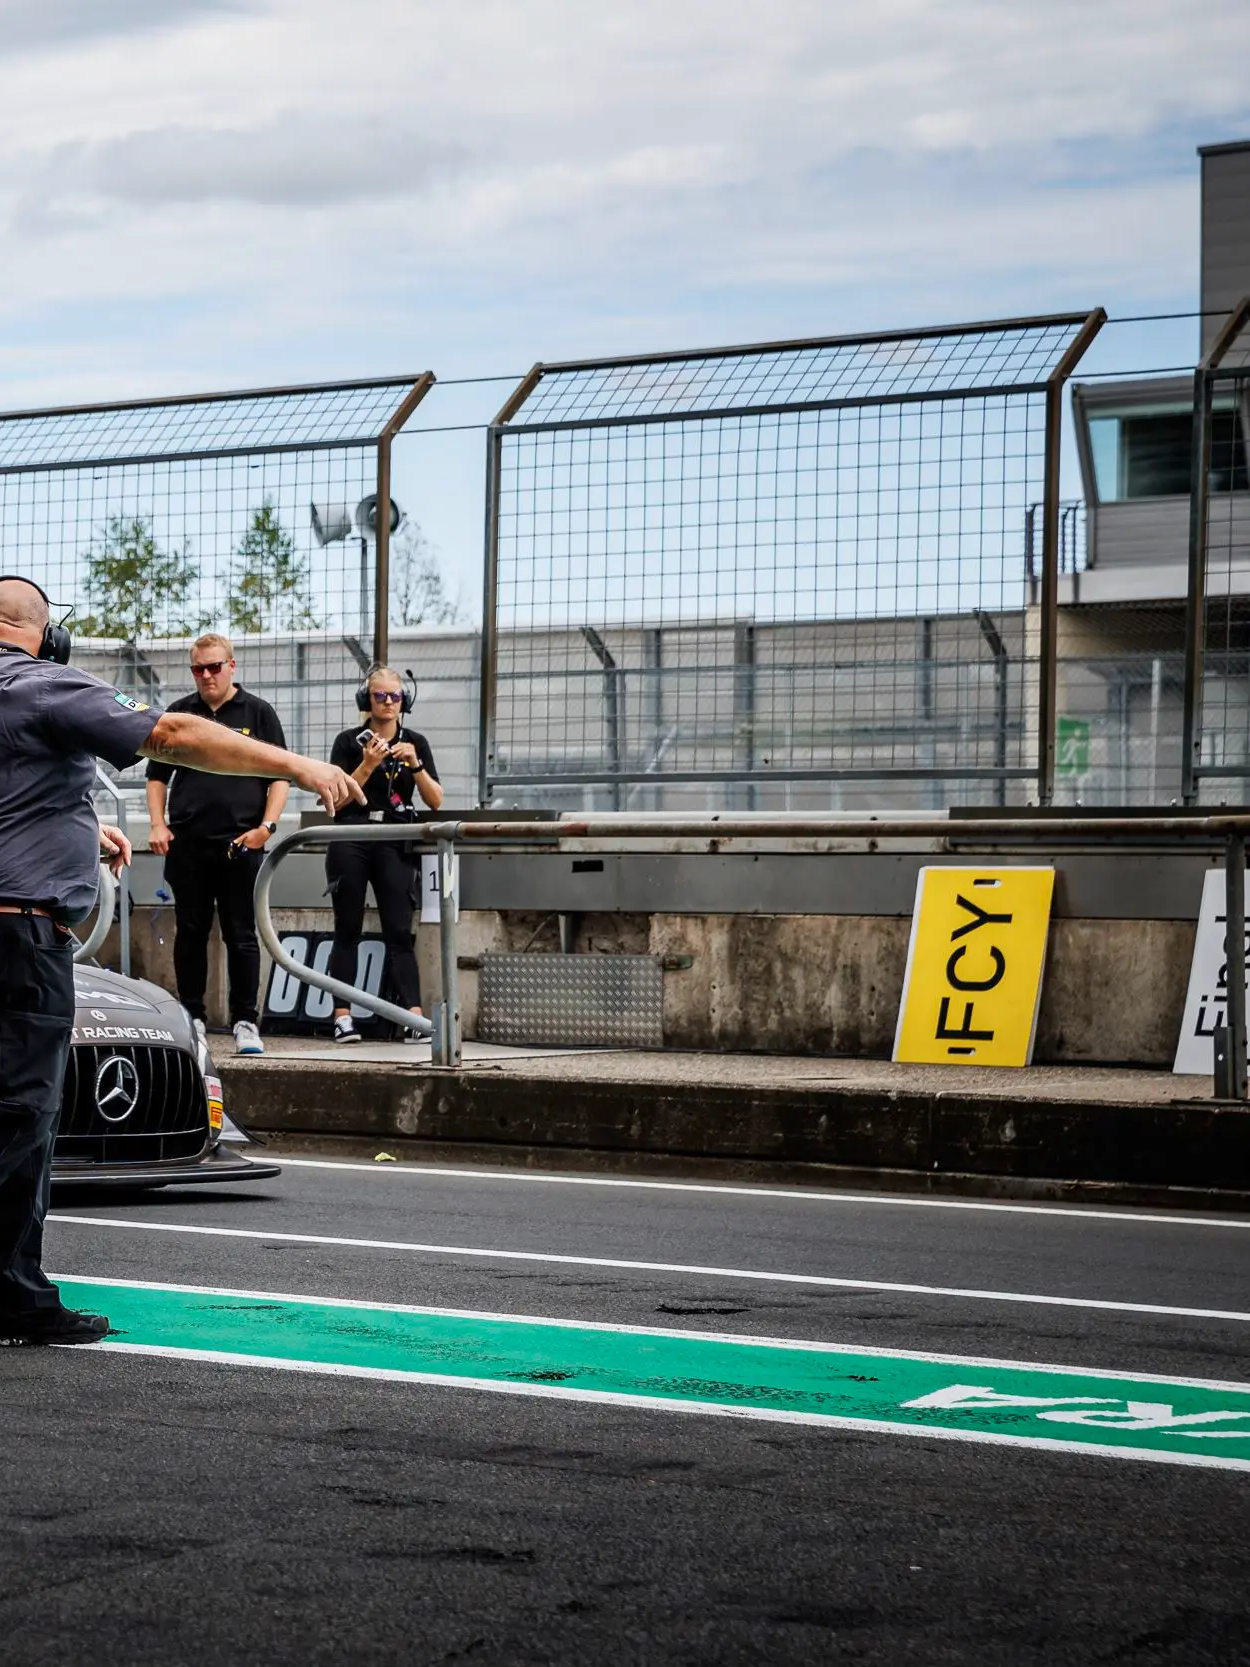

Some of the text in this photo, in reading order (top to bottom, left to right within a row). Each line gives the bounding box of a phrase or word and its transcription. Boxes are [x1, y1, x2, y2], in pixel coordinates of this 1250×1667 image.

[935, 894, 1013, 1041] FCY
[82, 1027, 139, 1039] RACING
[138, 1028, 175, 1042] TEAM
